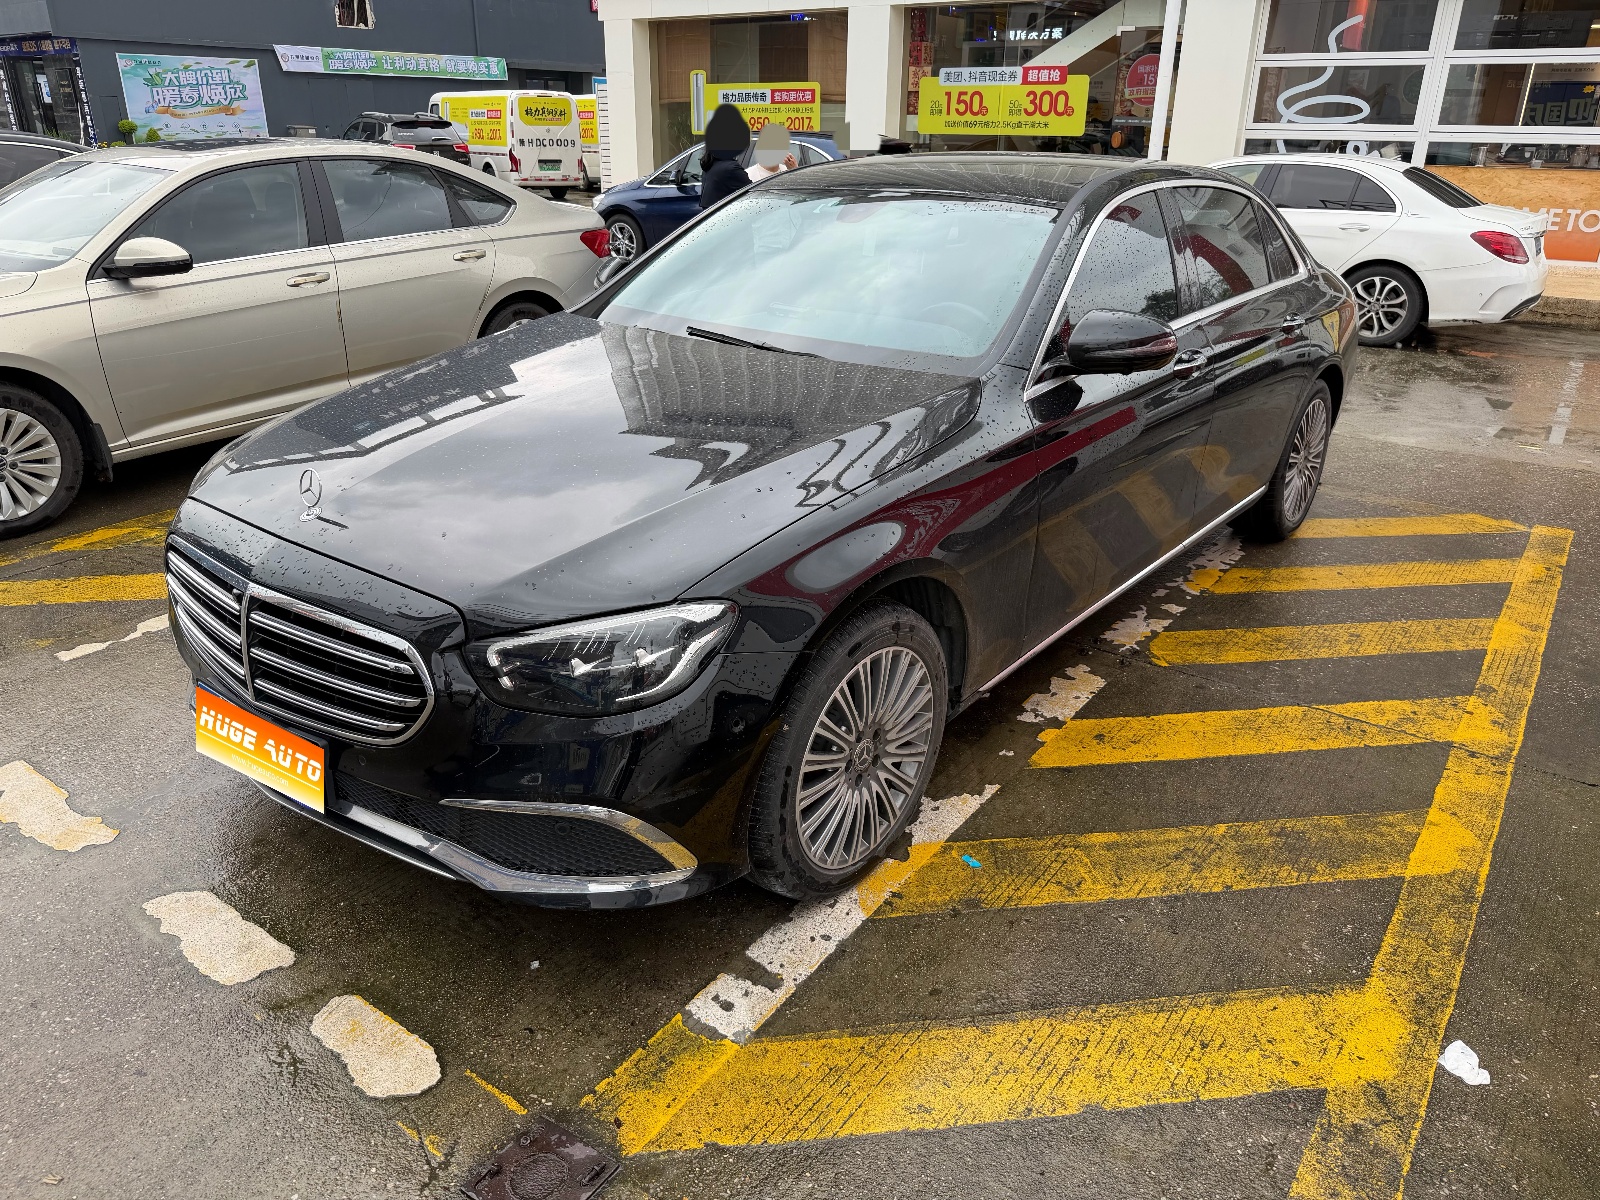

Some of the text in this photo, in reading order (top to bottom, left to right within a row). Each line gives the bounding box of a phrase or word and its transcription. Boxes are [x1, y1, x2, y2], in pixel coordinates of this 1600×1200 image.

[381, 55, 500, 75] 让利动真格 就要购实惠
[161, 70, 230, 86] 大牌价到
[943, 70, 1018, 83] 美团、抖音现金券
[1027, 69, 1061, 82] 超值抢
[151, 84, 245, 107] 暖春焕欣
[722, 91, 812, 103] 格力品质传奇 套购更优惠
